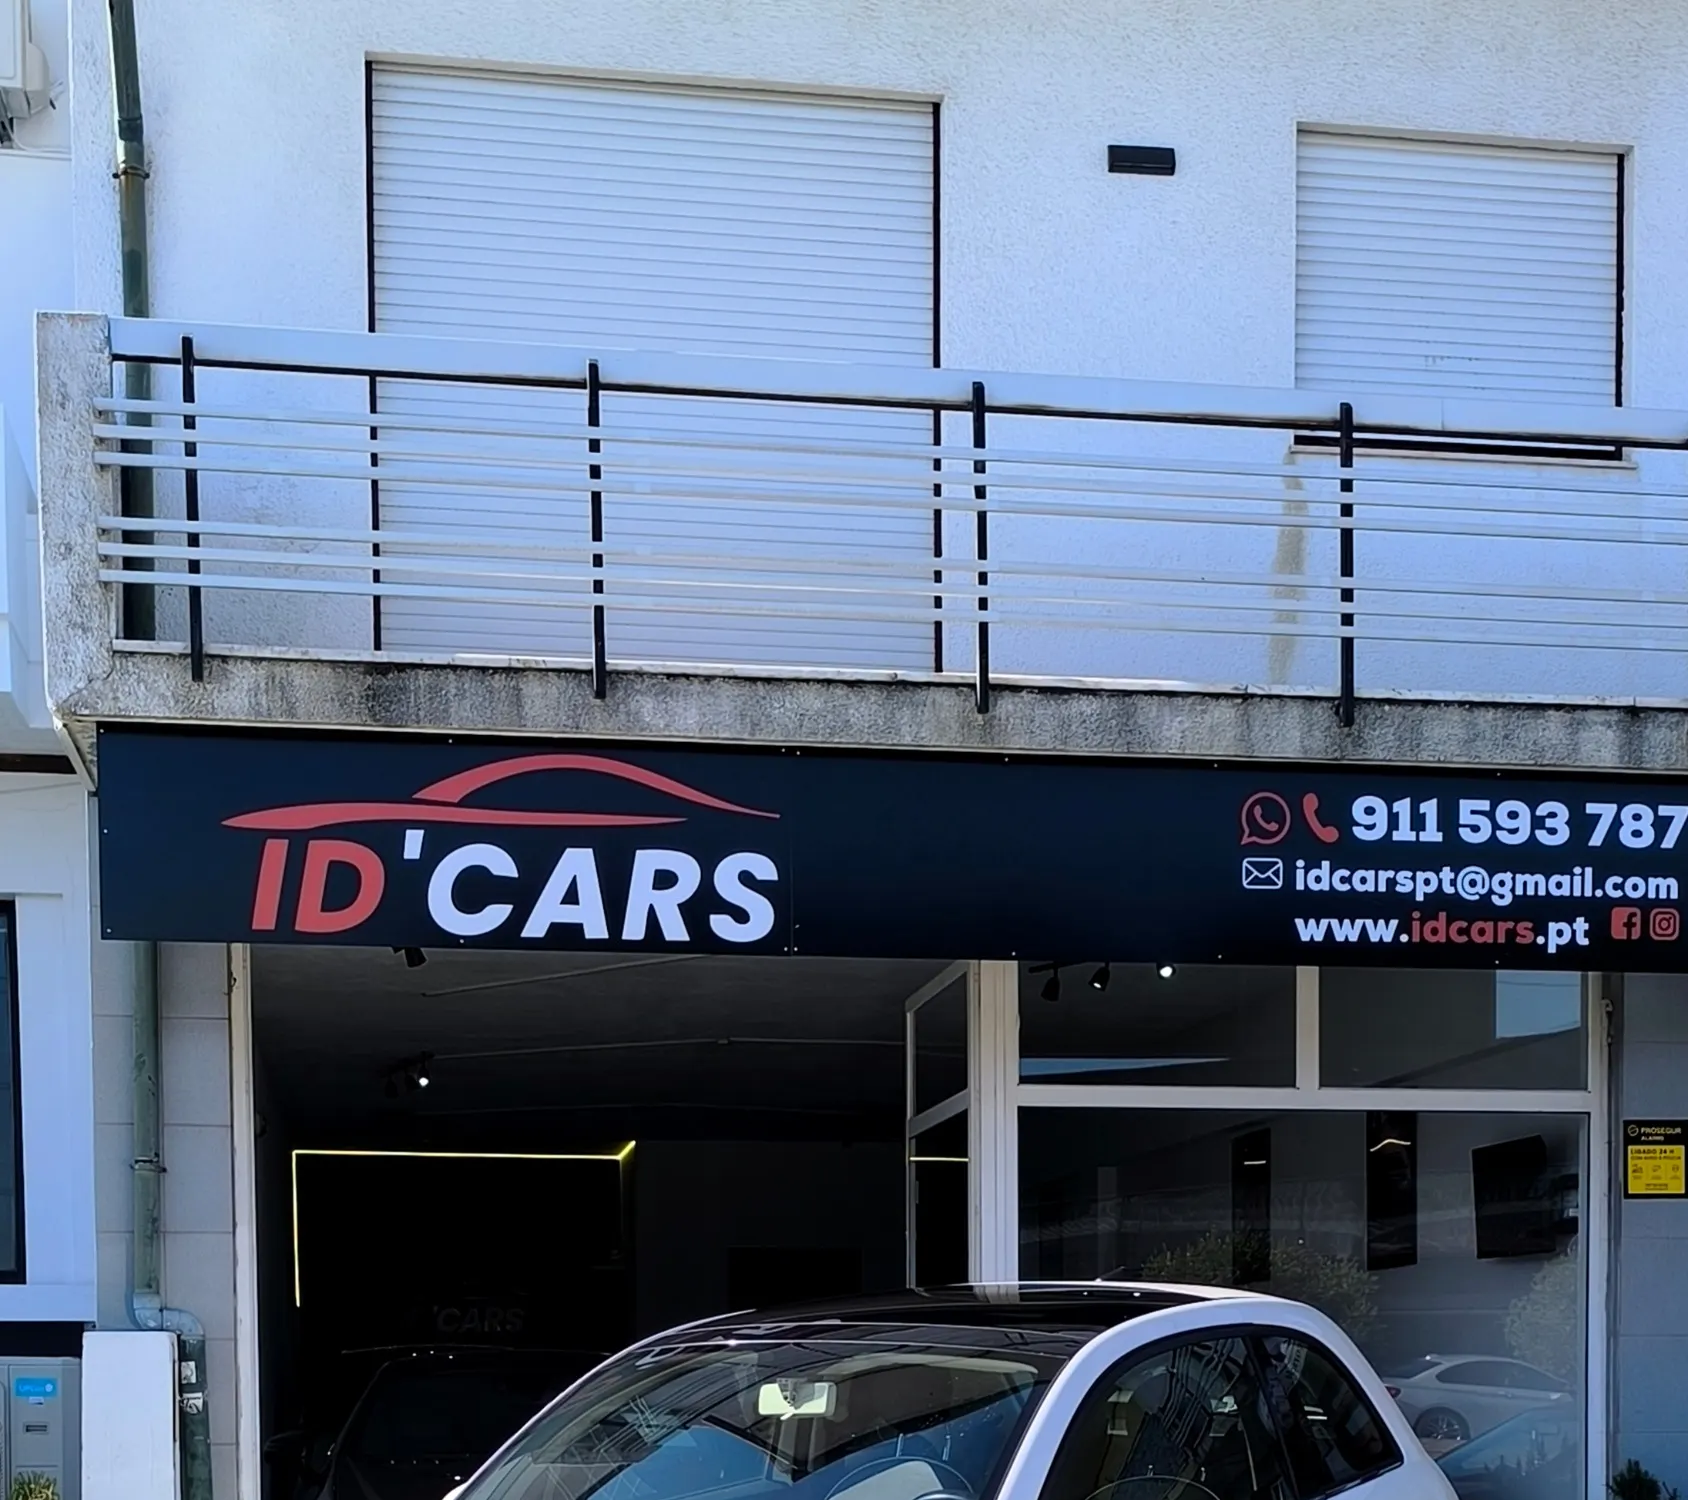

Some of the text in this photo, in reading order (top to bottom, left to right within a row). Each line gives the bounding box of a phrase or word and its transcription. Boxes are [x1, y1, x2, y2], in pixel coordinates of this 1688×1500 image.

[1351, 795, 1688, 849] 911 593 787
[251, 829, 779, 943] ID'CARS
[1295, 860, 1679, 906] idcarspt@gmail.com
[1294, 911, 1590, 953] www.idcars.pt
[1640, 1126, 1682, 1134] PROSEGUR
